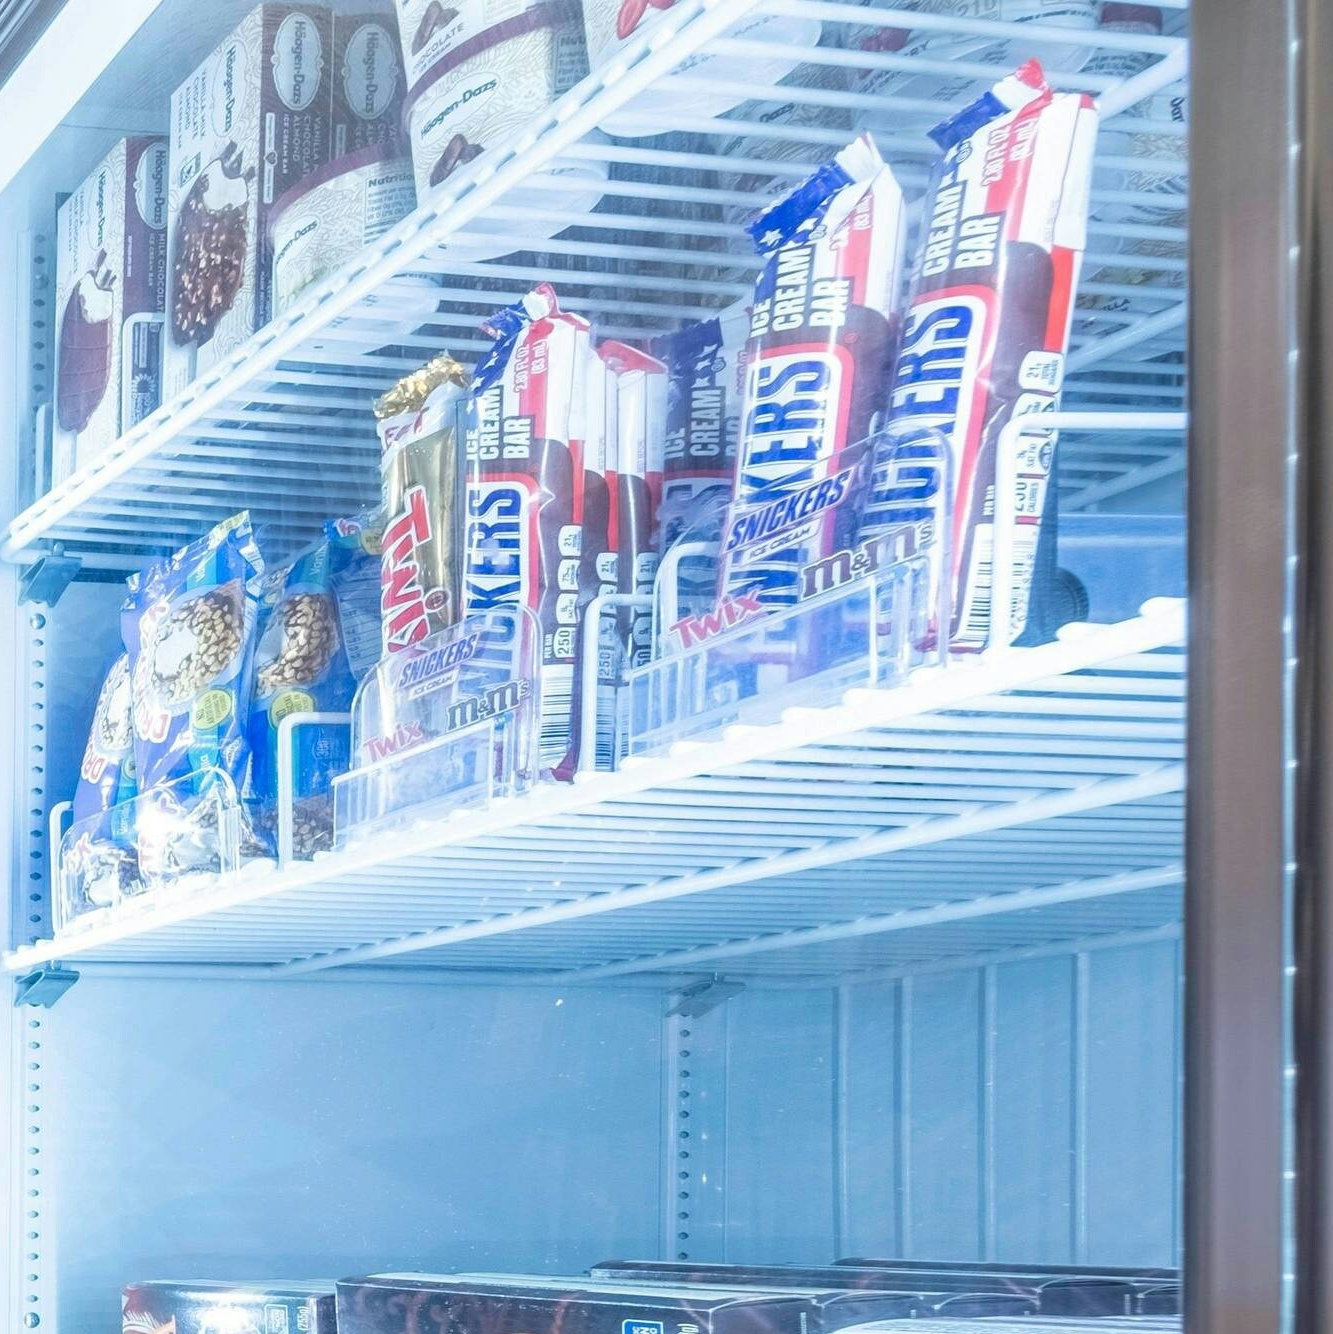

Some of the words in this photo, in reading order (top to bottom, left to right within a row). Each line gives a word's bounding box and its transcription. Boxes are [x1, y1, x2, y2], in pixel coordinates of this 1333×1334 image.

[921, 185, 961, 277] CREAM
[954, 213, 1002, 270] BAR
[773, 240, 812, 331] CREAM
[809, 279, 849, 328] BAR
[480, 387, 501, 461] CREAM
[503, 417, 531, 460] BAR
[689, 388, 722, 457] CREAM
[728, 468, 853, 551] SNICKERS
[775, 524, 813, 548] CREAM
[397, 634, 478, 687] SNICKERS
[557, 629, 571, 657] 250
[363, 719, 423, 762] Twix
